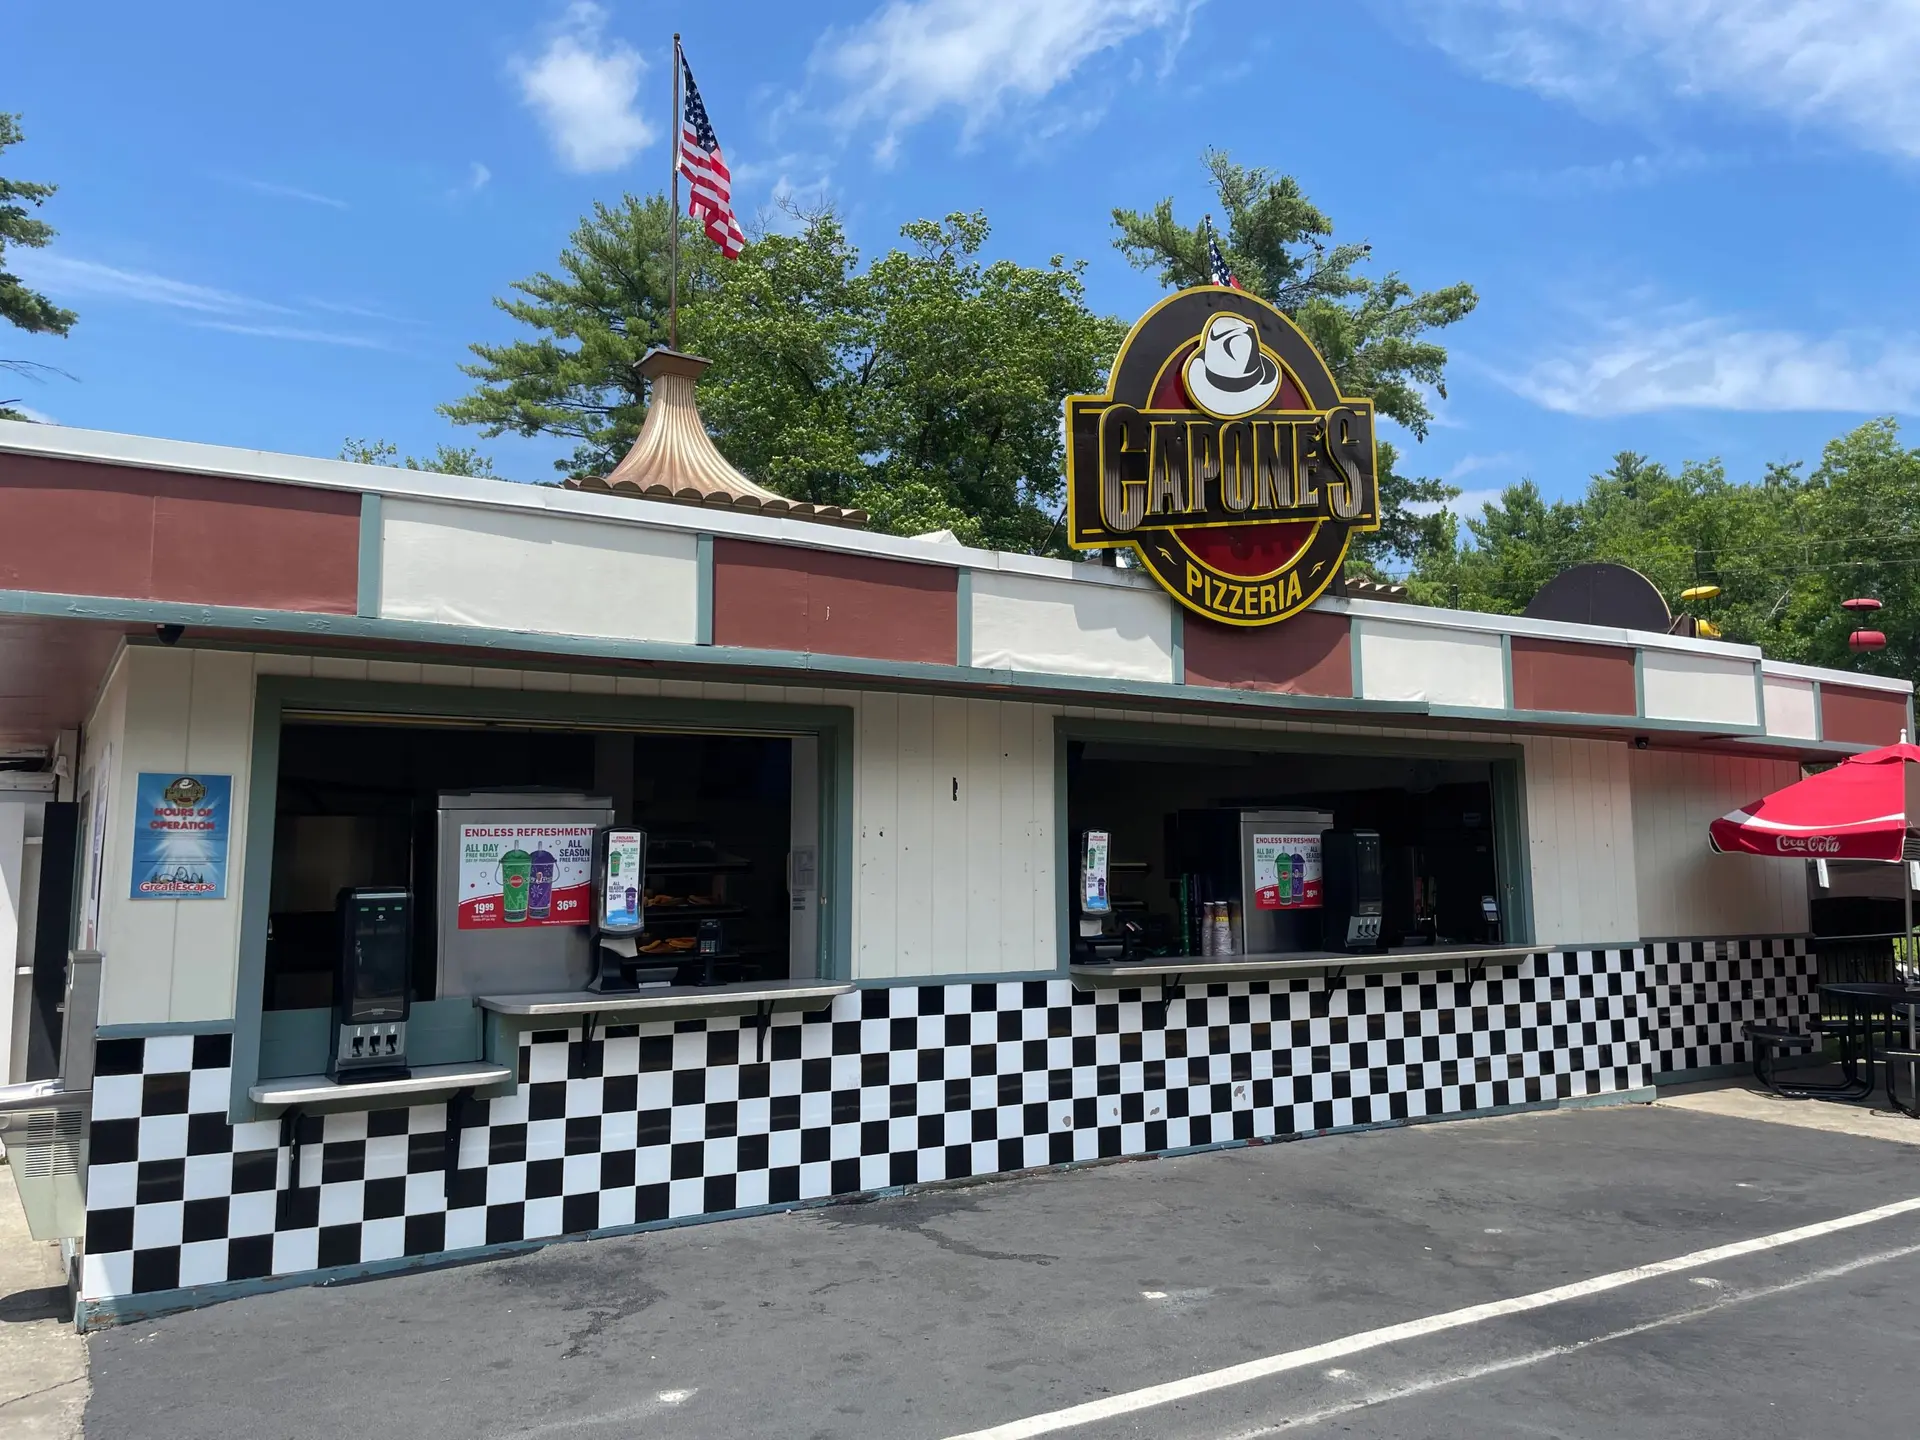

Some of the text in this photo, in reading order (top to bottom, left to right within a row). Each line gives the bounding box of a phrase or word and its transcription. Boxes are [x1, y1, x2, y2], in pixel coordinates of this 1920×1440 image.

[1099, 403, 1364, 533] CAPONE'S
[1185, 559, 1303, 616] PIZZERIA
[155, 808, 212, 816] HOURS OF
[150, 821, 214, 830] OPERATION
[465, 827, 593, 837] ENDLESS REFRESHMENT
[465, 843, 499, 852] ALL DAY
[568, 839, 582, 848] ALL
[559, 848, 590, 857] SEASON
[140, 882, 216, 893] Great Escape
